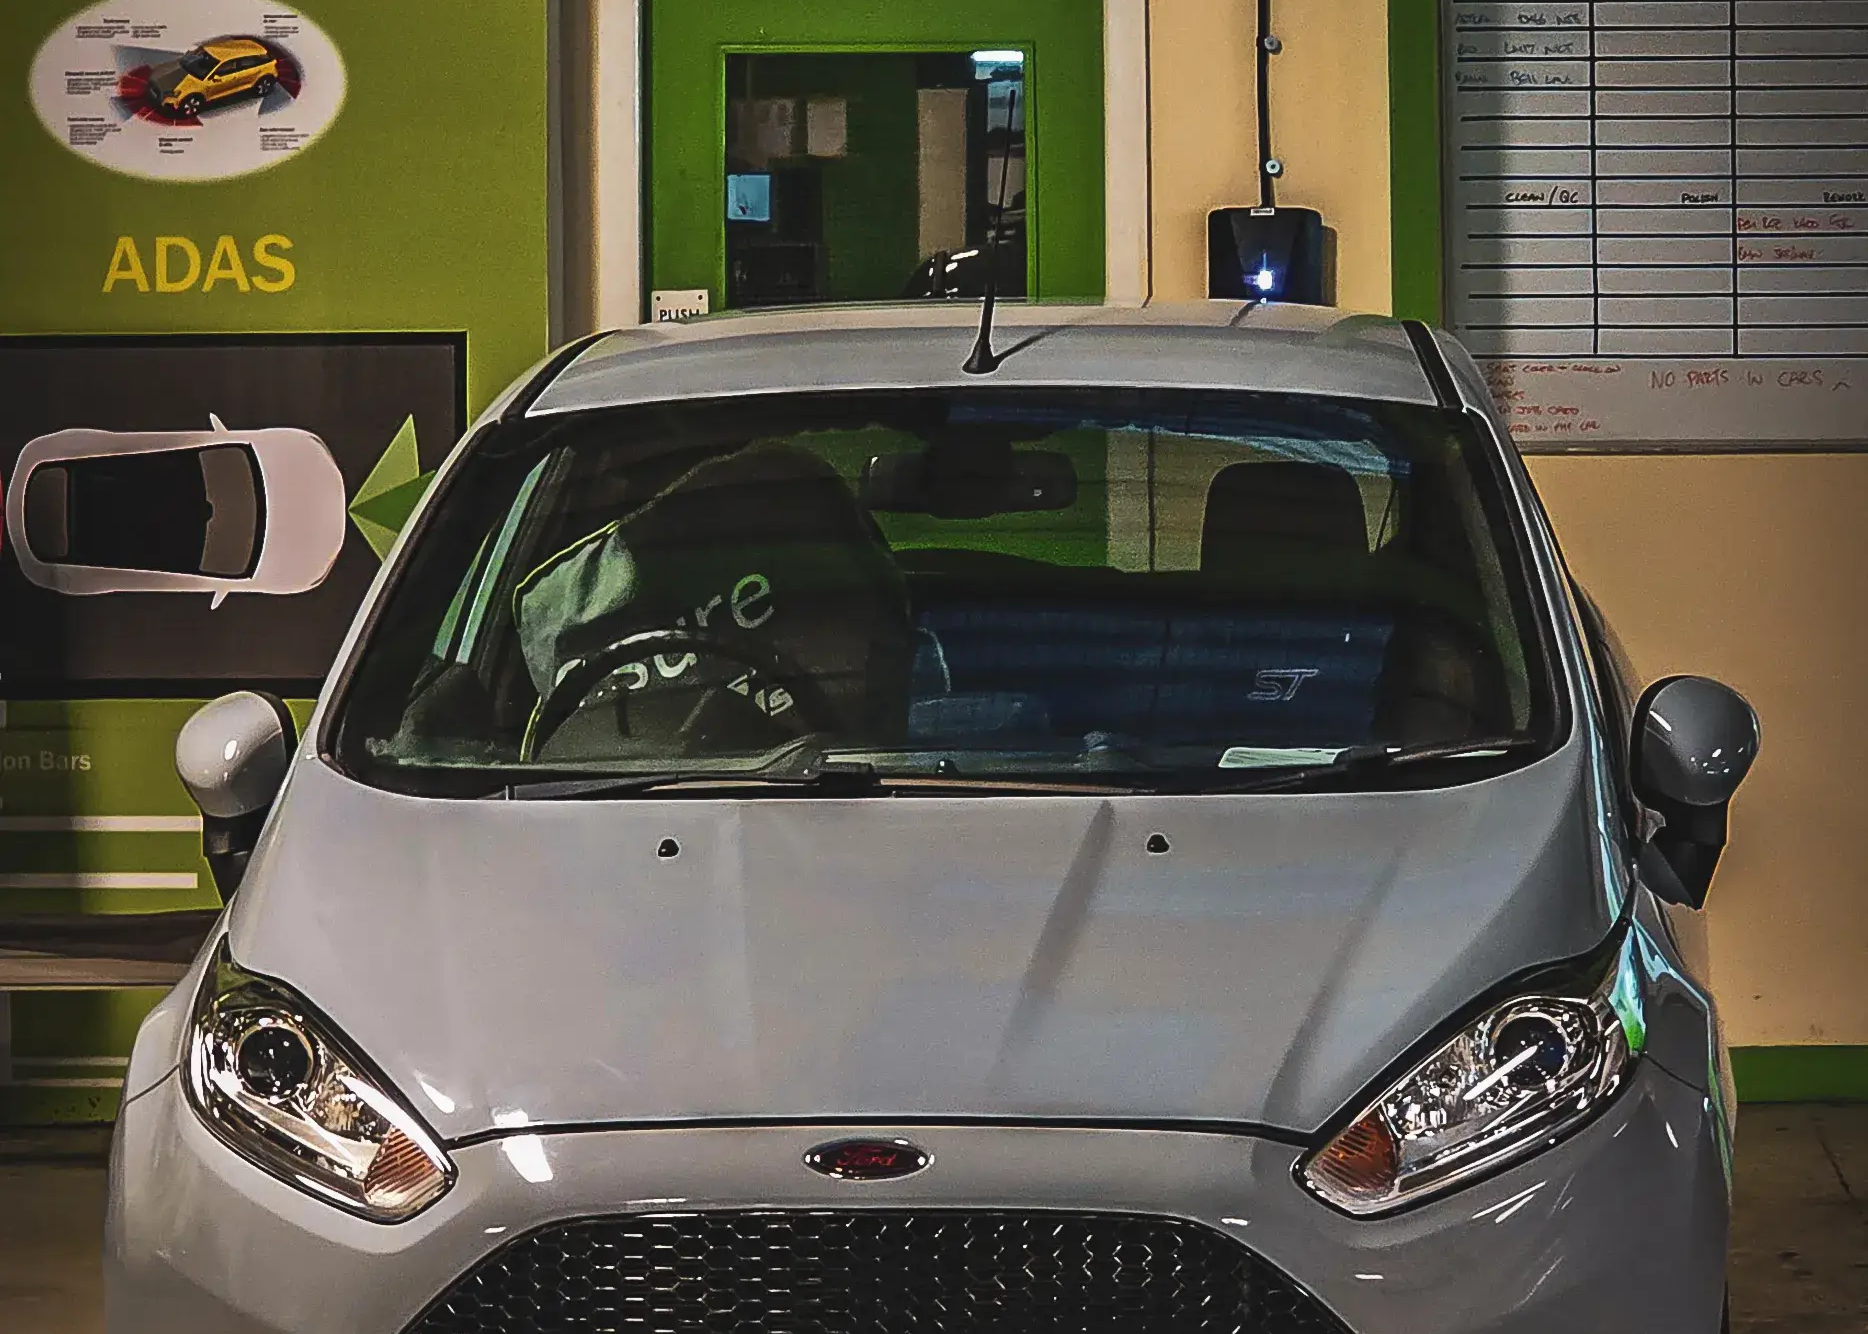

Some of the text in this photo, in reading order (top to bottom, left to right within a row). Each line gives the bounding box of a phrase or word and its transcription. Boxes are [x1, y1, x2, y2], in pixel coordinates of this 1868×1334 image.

[102, 234, 296, 293] ADAS
[1651, 369, 1823, 388] NO PARTS IN CARS
[1247, 668, 1319, 701] ST
[0, 750, 92, 771] on Bars
